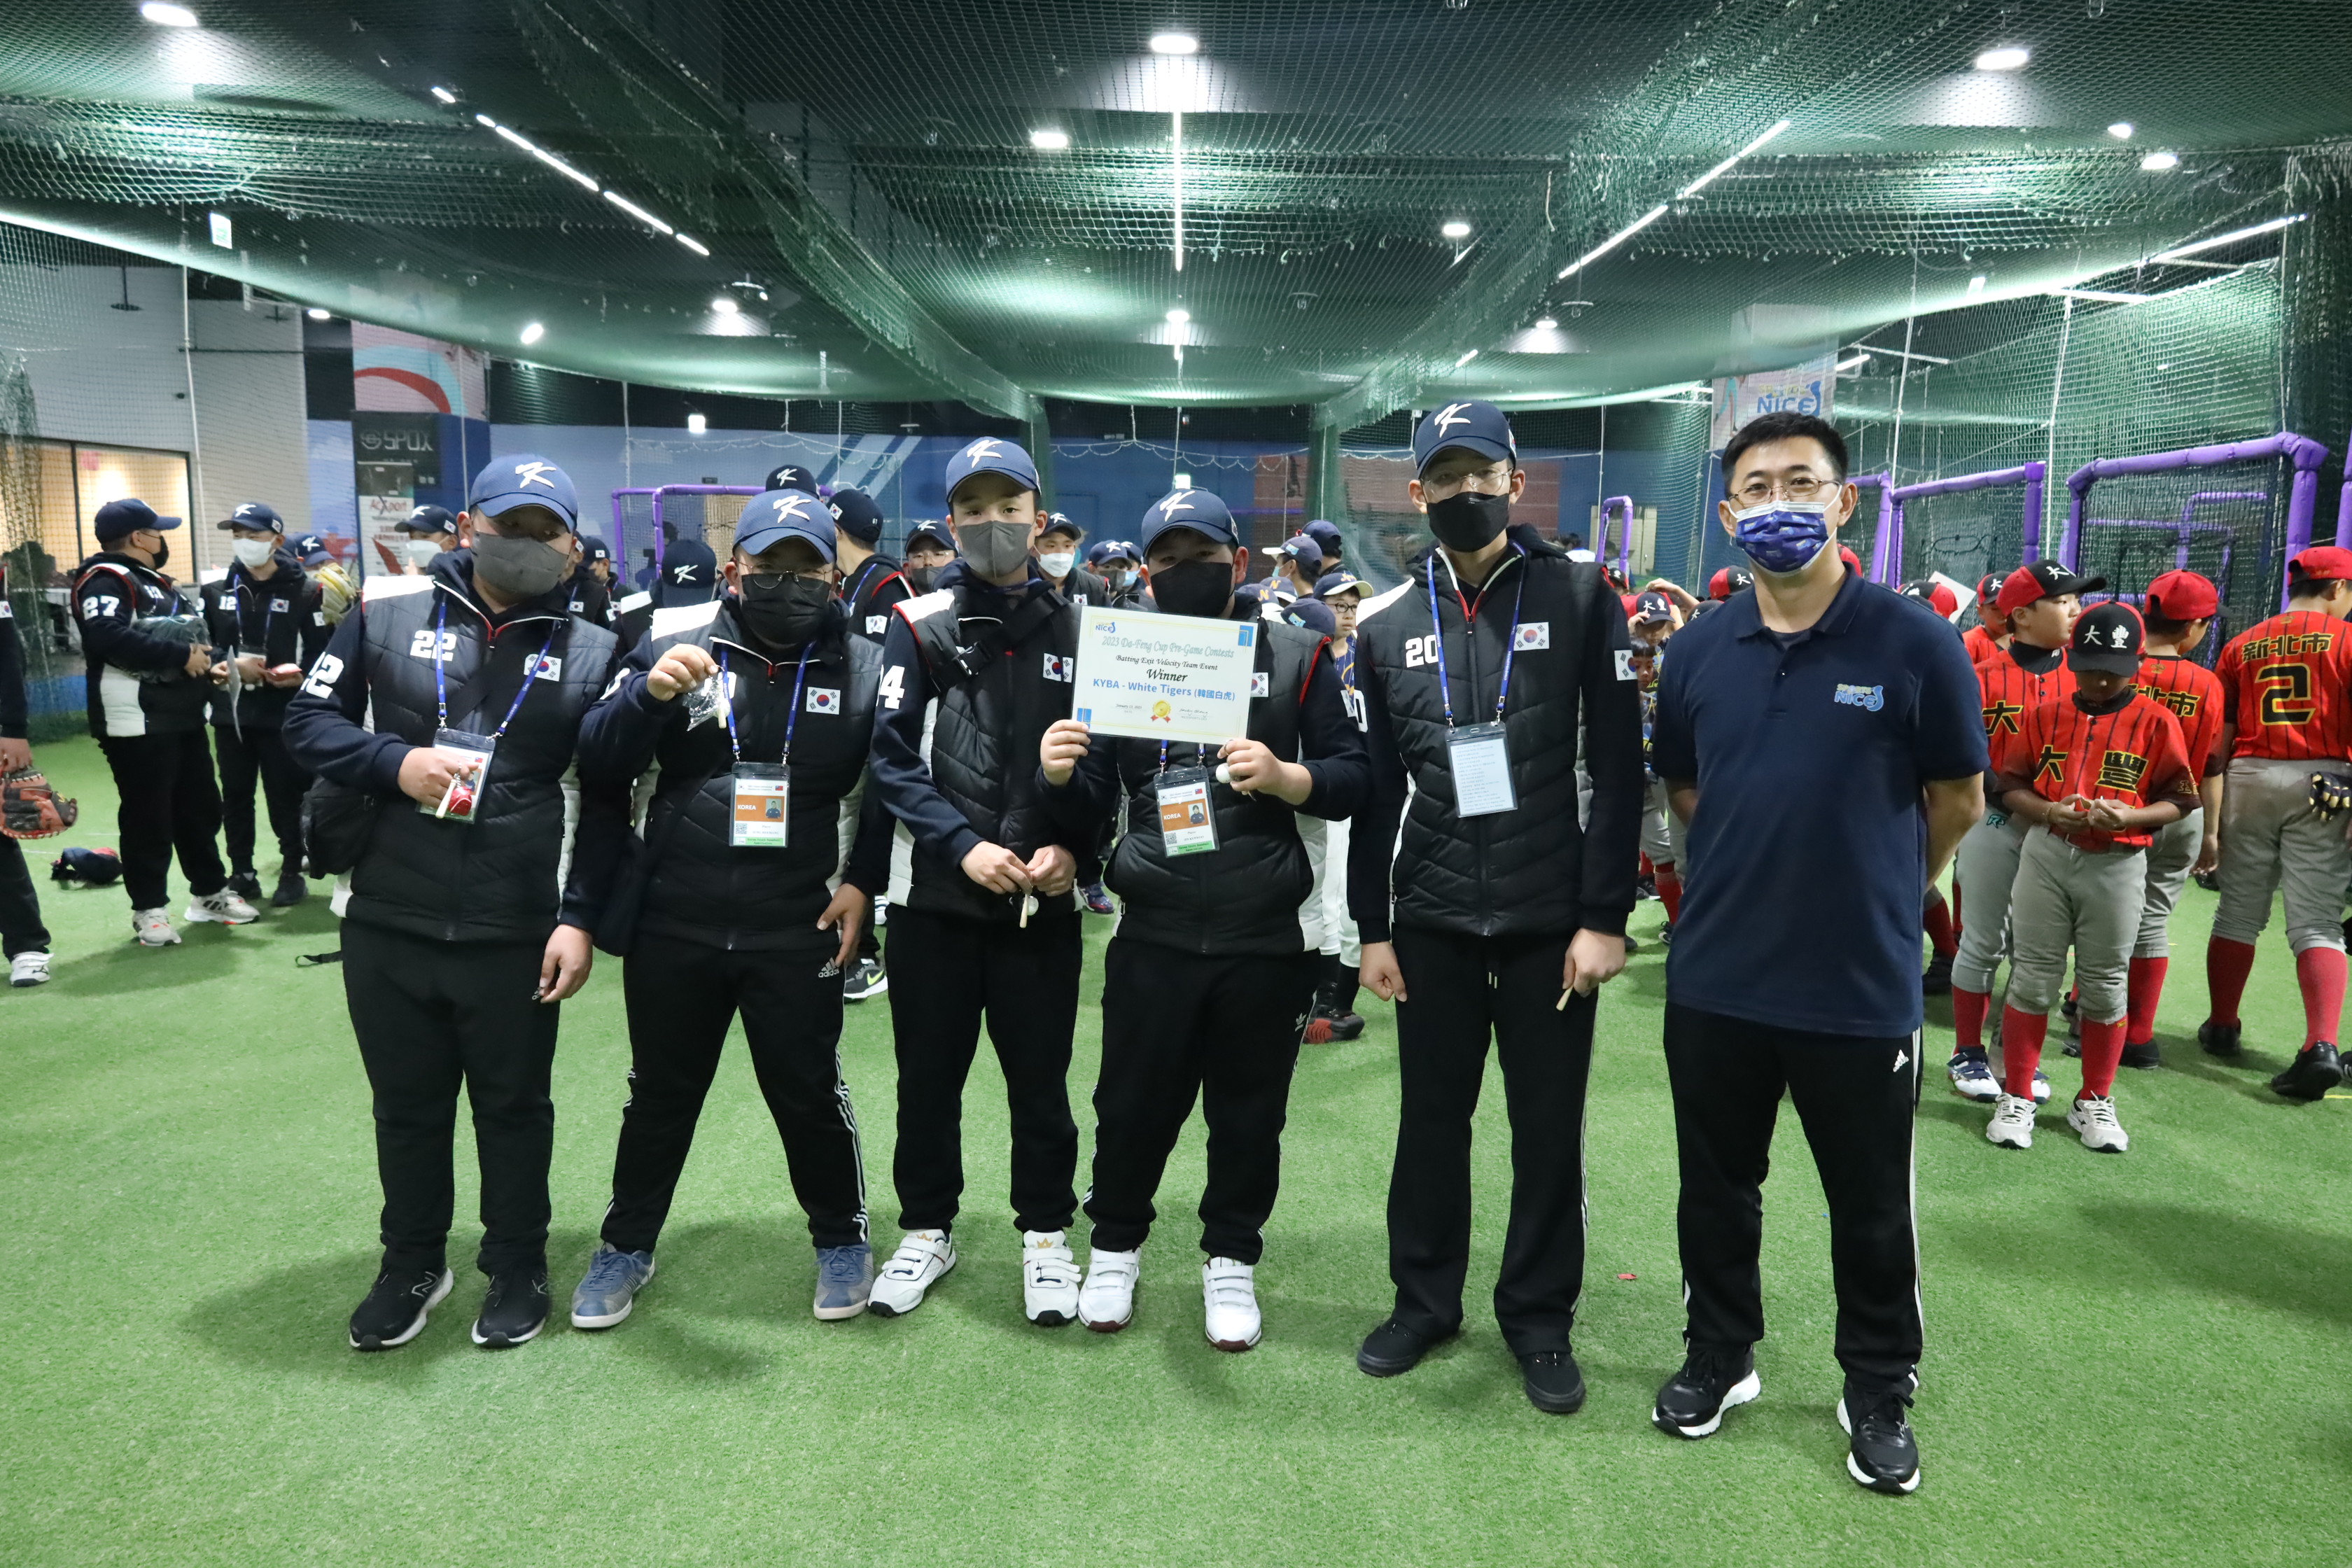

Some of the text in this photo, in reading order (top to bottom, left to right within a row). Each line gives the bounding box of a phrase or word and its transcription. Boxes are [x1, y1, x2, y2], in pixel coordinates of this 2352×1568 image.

[1757, 389, 1821, 416] NICE
[1736, 573, 1754, 586] 大
[2046, 564, 2077, 580] 大
[82, 595, 120, 621] 27
[218, 595, 237, 610] 12
[410, 629, 457, 662] 22
[1101, 636, 1234, 658] 2023 Da-Feng Cup Pre-Game Contests
[2083, 624, 2129, 649] 大豐
[2241, 631, 2334, 664] 新北市
[1115, 654, 1140, 664] Batting
[1156, 658, 1181, 668] Velocity
[1405, 634, 1439, 668] 20
[876, 664, 905, 710] 4
[1093, 678, 1119, 689] KYBA
[1128, 681, 1157, 692] White
[1160, 684, 1191, 696] Tigers
[1146, 668, 1188, 682] Winner
[1834, 689, 1884, 711] NICE
[2128, 683, 2201, 718] 北市
[2254, 662, 2316, 726] 2
[1982, 700, 2024, 736] 大
[2033, 744, 2149, 794] 大豐
[818, 968, 840, 978] adidas
